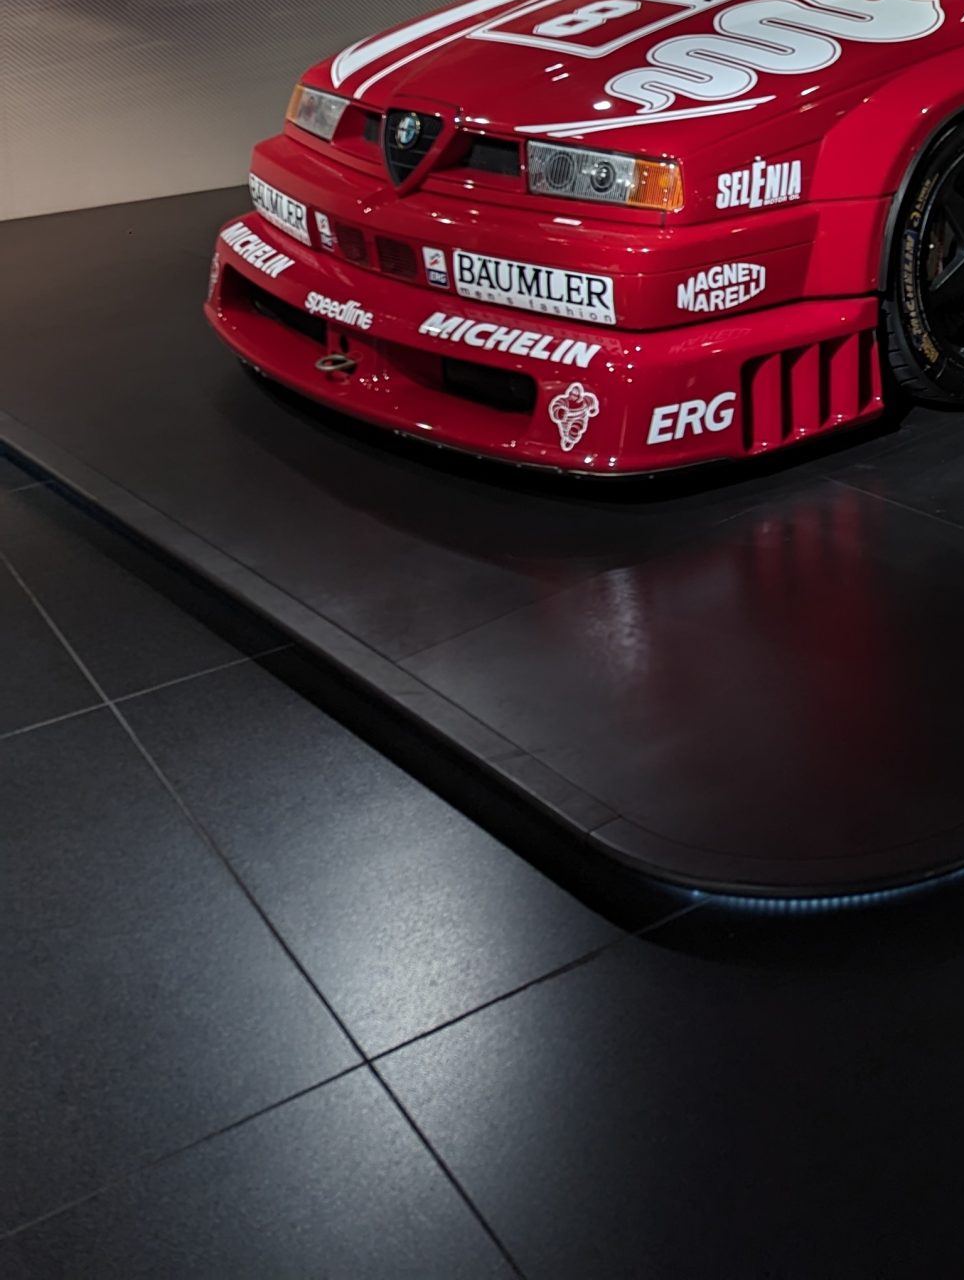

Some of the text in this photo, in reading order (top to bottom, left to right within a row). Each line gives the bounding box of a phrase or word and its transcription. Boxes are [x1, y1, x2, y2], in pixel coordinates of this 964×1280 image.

[220, 221, 296, 279] MICHELIN
[458, 254, 610, 309] BÄUMLER
[677, 263, 766, 302] MAGNETI
[677, 280, 766, 312] MARELLI
[305, 290, 375, 330] speedline
[418, 312, 601, 368] MICHELIN
[646, 391, 737, 445] ERG
